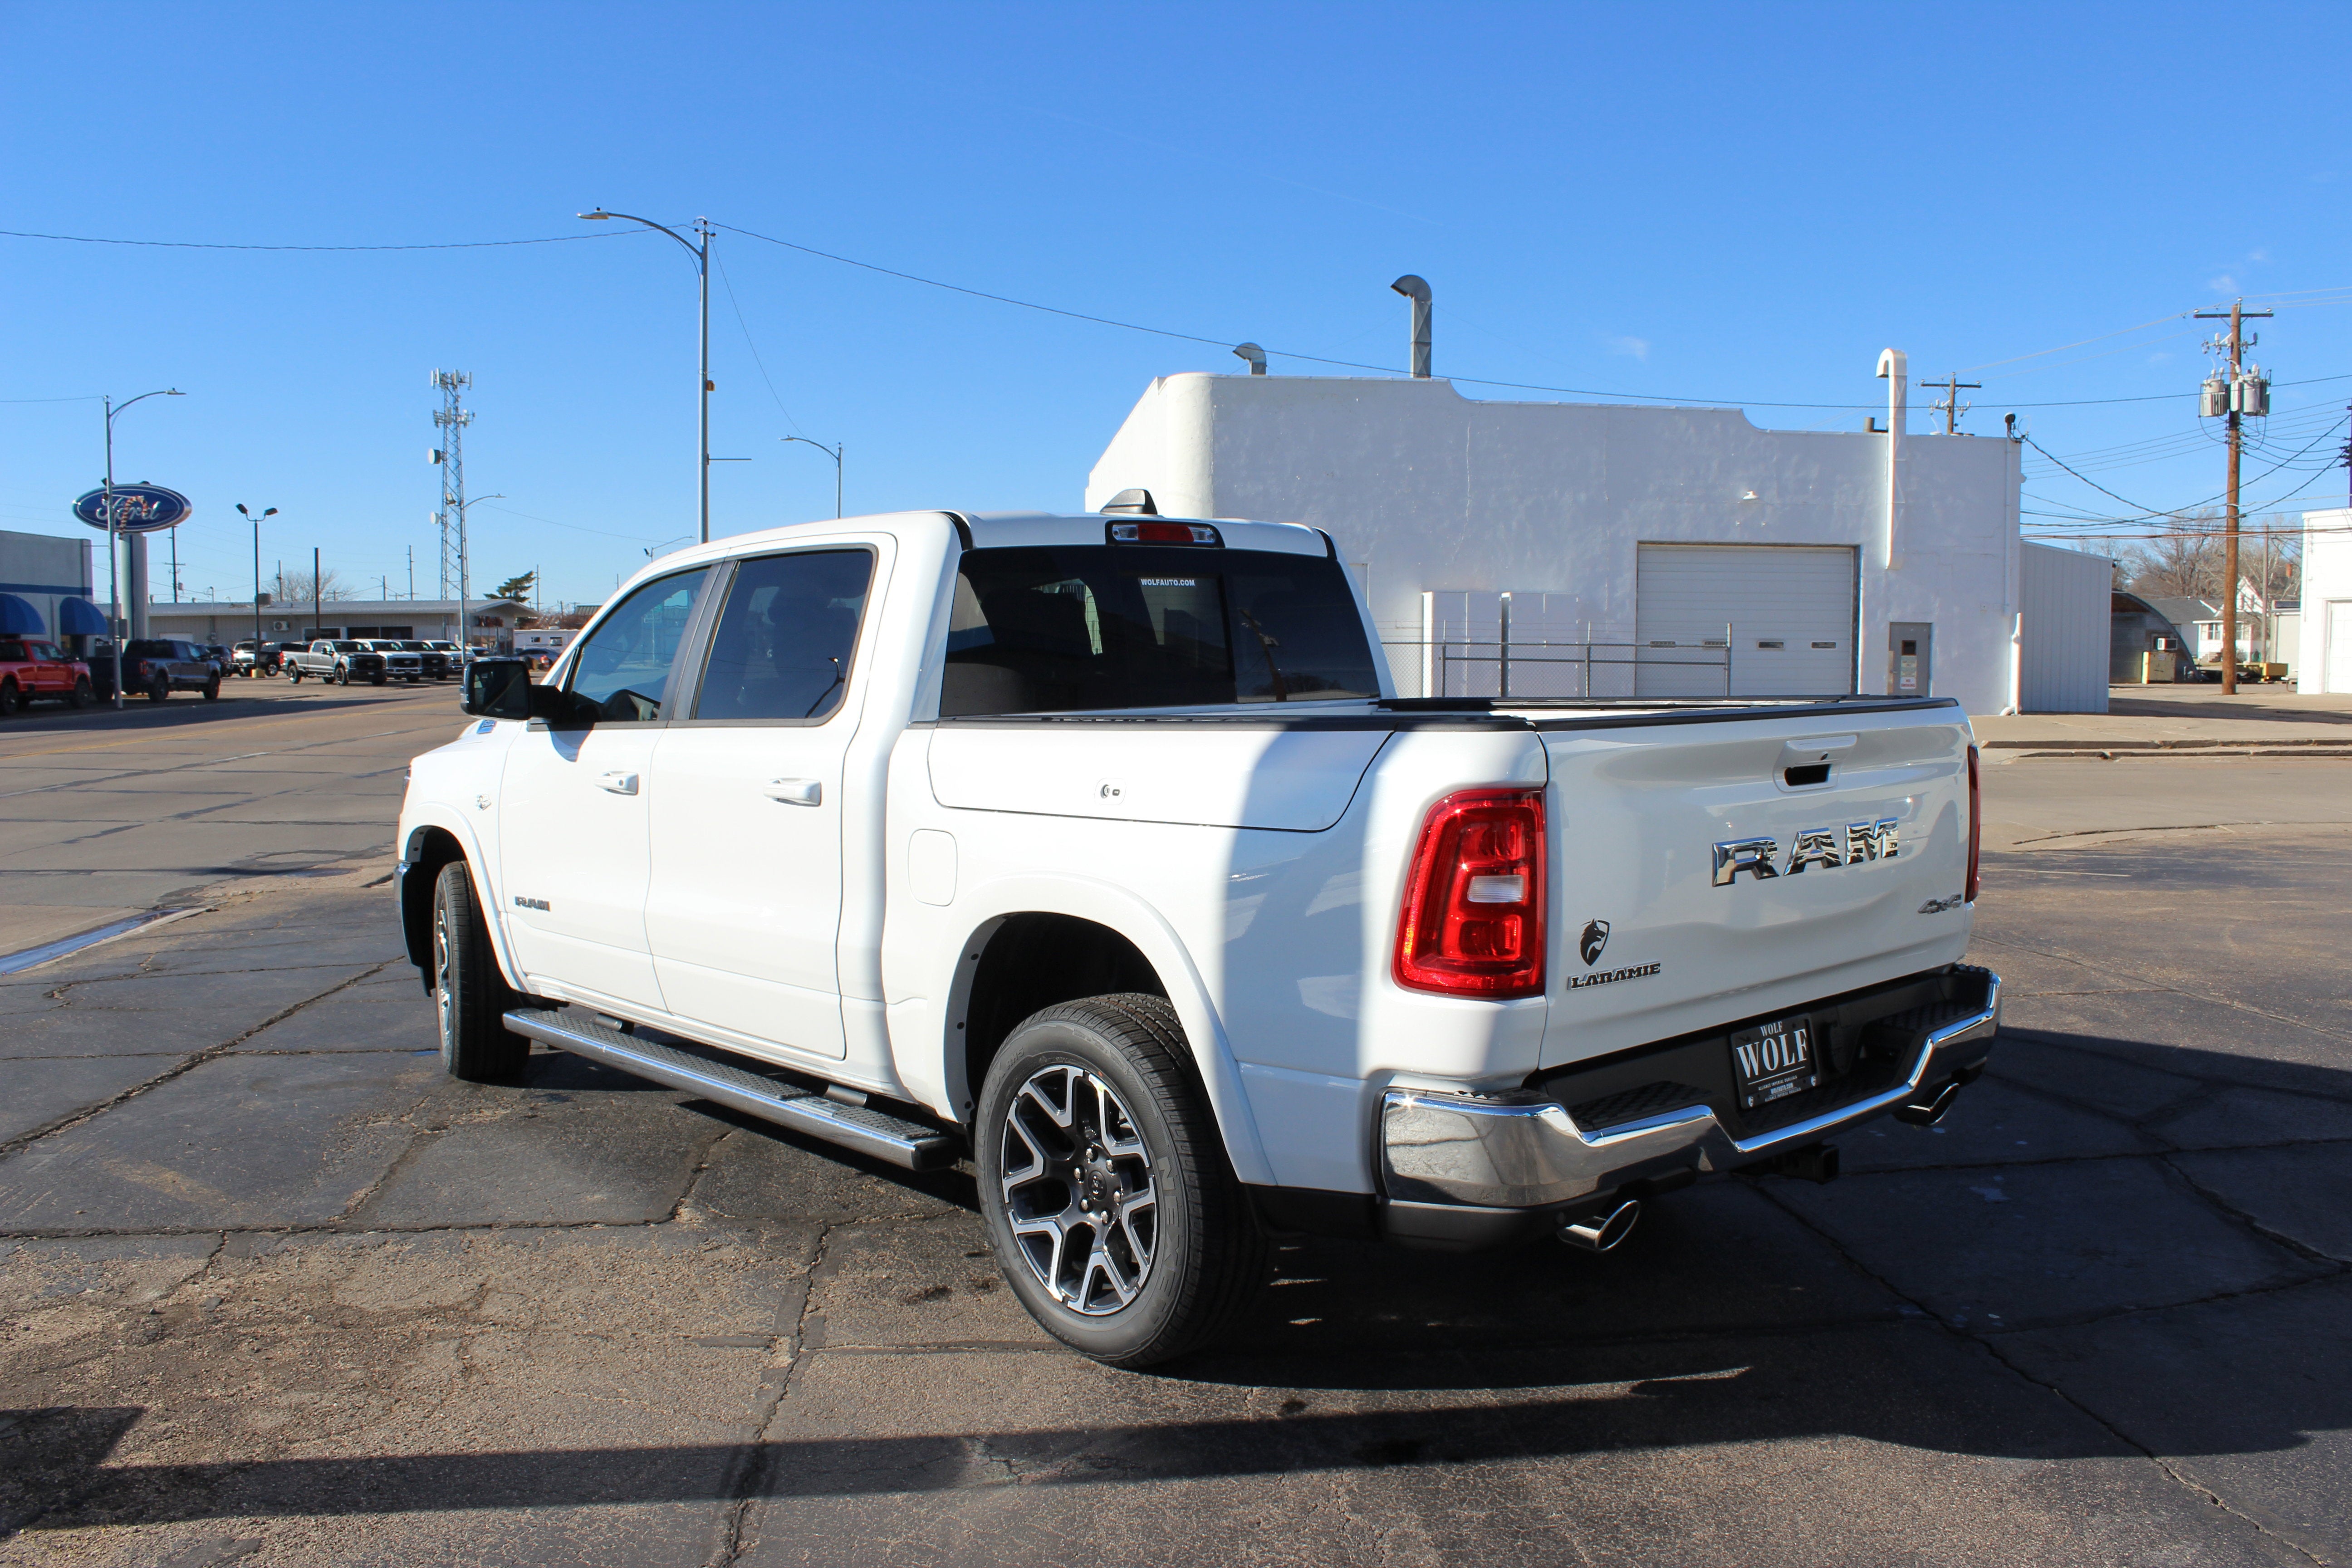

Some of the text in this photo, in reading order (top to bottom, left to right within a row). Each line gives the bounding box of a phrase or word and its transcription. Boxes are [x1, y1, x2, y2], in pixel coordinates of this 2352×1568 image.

[96, 494, 161, 520] Ford
[1712, 817, 1899, 887] RAM
[514, 896, 551, 911] RAM
[1567, 960, 1661, 990] LARAMIE
[1760, 1021, 1783, 1037] WOLF
[1736, 1029, 1807, 1078] WOLF
[1149, 1156, 1180, 1326] NEXEN
